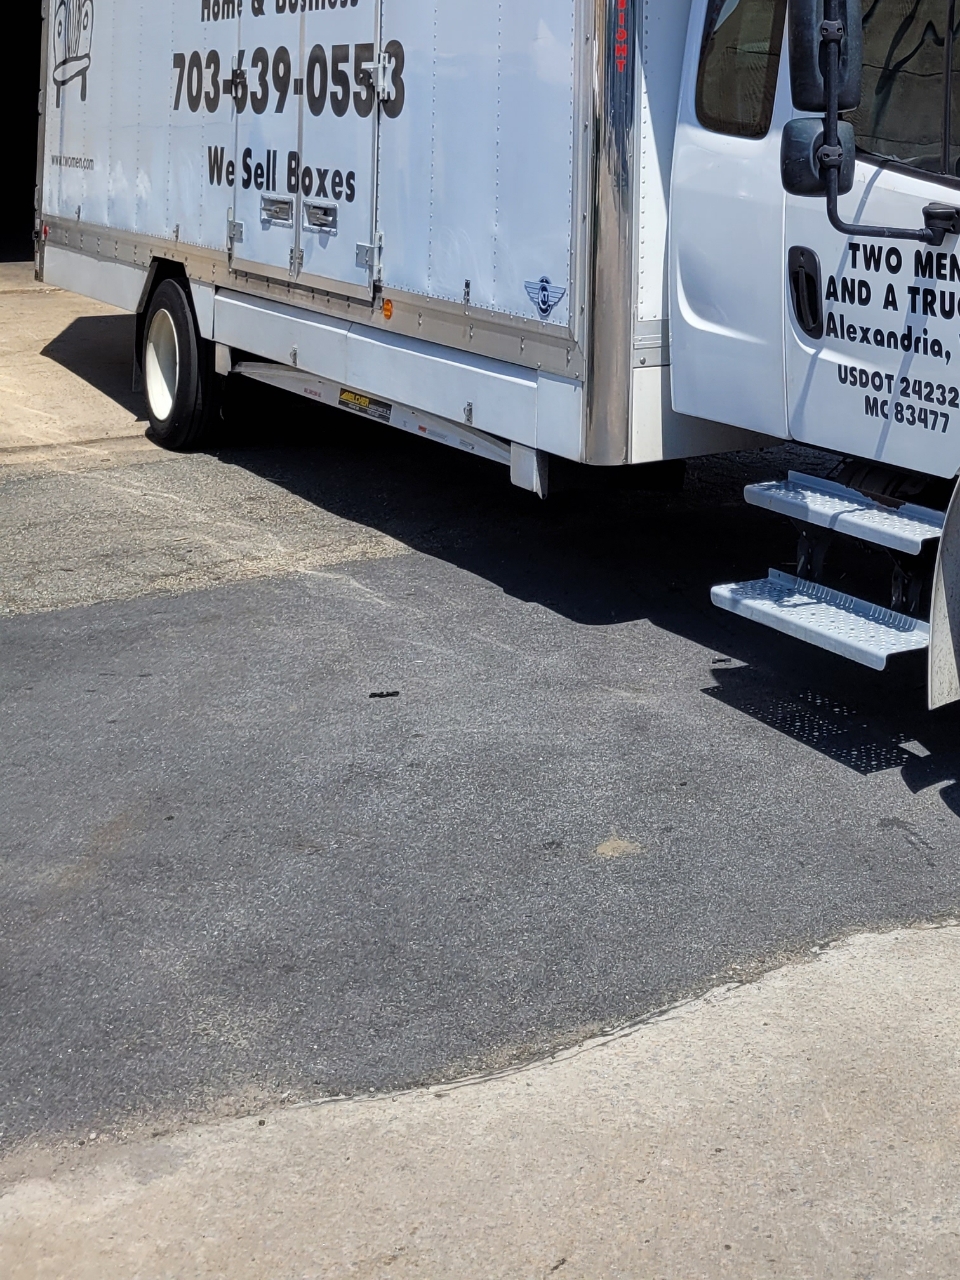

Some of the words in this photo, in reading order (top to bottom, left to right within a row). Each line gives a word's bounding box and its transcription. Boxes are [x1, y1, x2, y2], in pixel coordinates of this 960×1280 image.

[173, 39, 405, 118] 703-639-0553
[208, 145, 235, 187] We
[242, 147, 277, 191] Sell
[286, 151, 355, 202] Boxes
[848, 242, 902, 274] TWO
[825, 276, 871, 307] AND
[882, 282, 899, 312] A
[824, 312, 951, 365] Alexandria,
[837, 364, 894, 396] USDOT
[864, 395, 889, 419] MC
[894, 400, 949, 434] 83477
